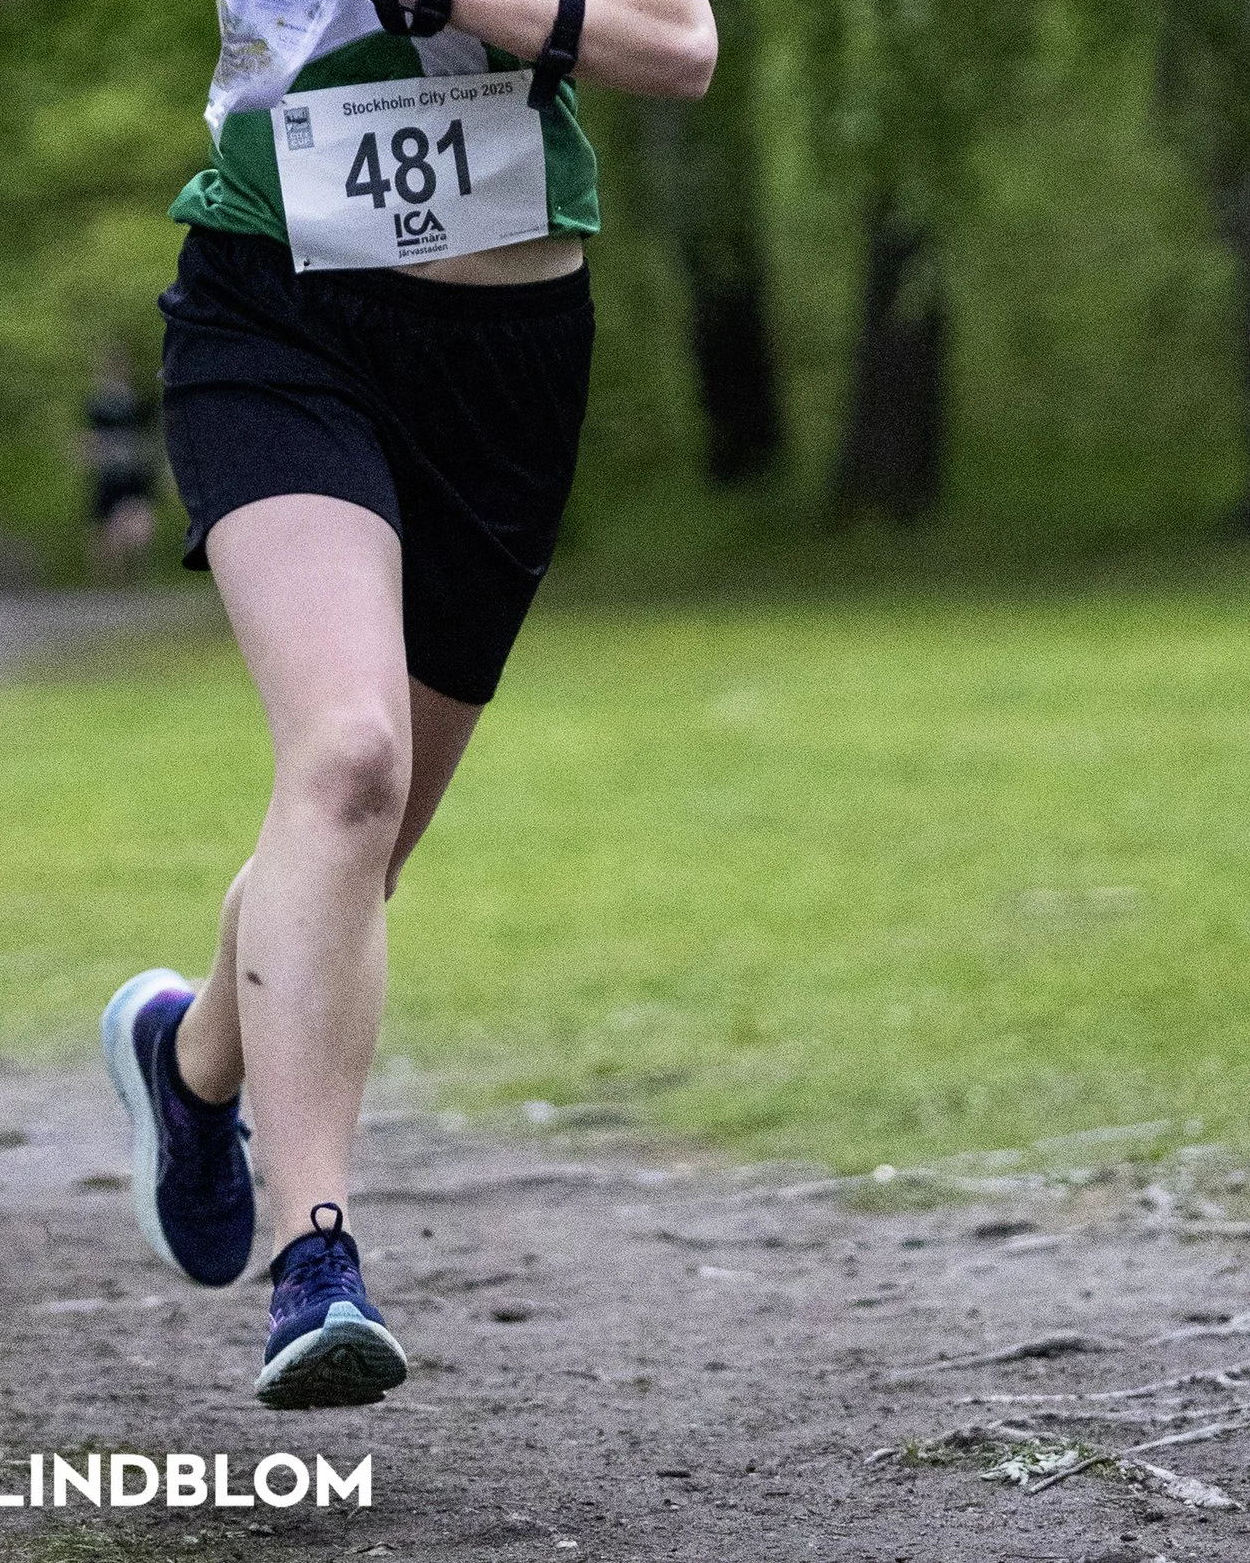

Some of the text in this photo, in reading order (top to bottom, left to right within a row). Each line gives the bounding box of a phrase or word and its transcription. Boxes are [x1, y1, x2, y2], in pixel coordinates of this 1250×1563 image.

[343, 81, 513, 117] Stockholm City Cup 2025
[345, 119, 472, 209] 481
[394, 209, 445, 238] ICA
